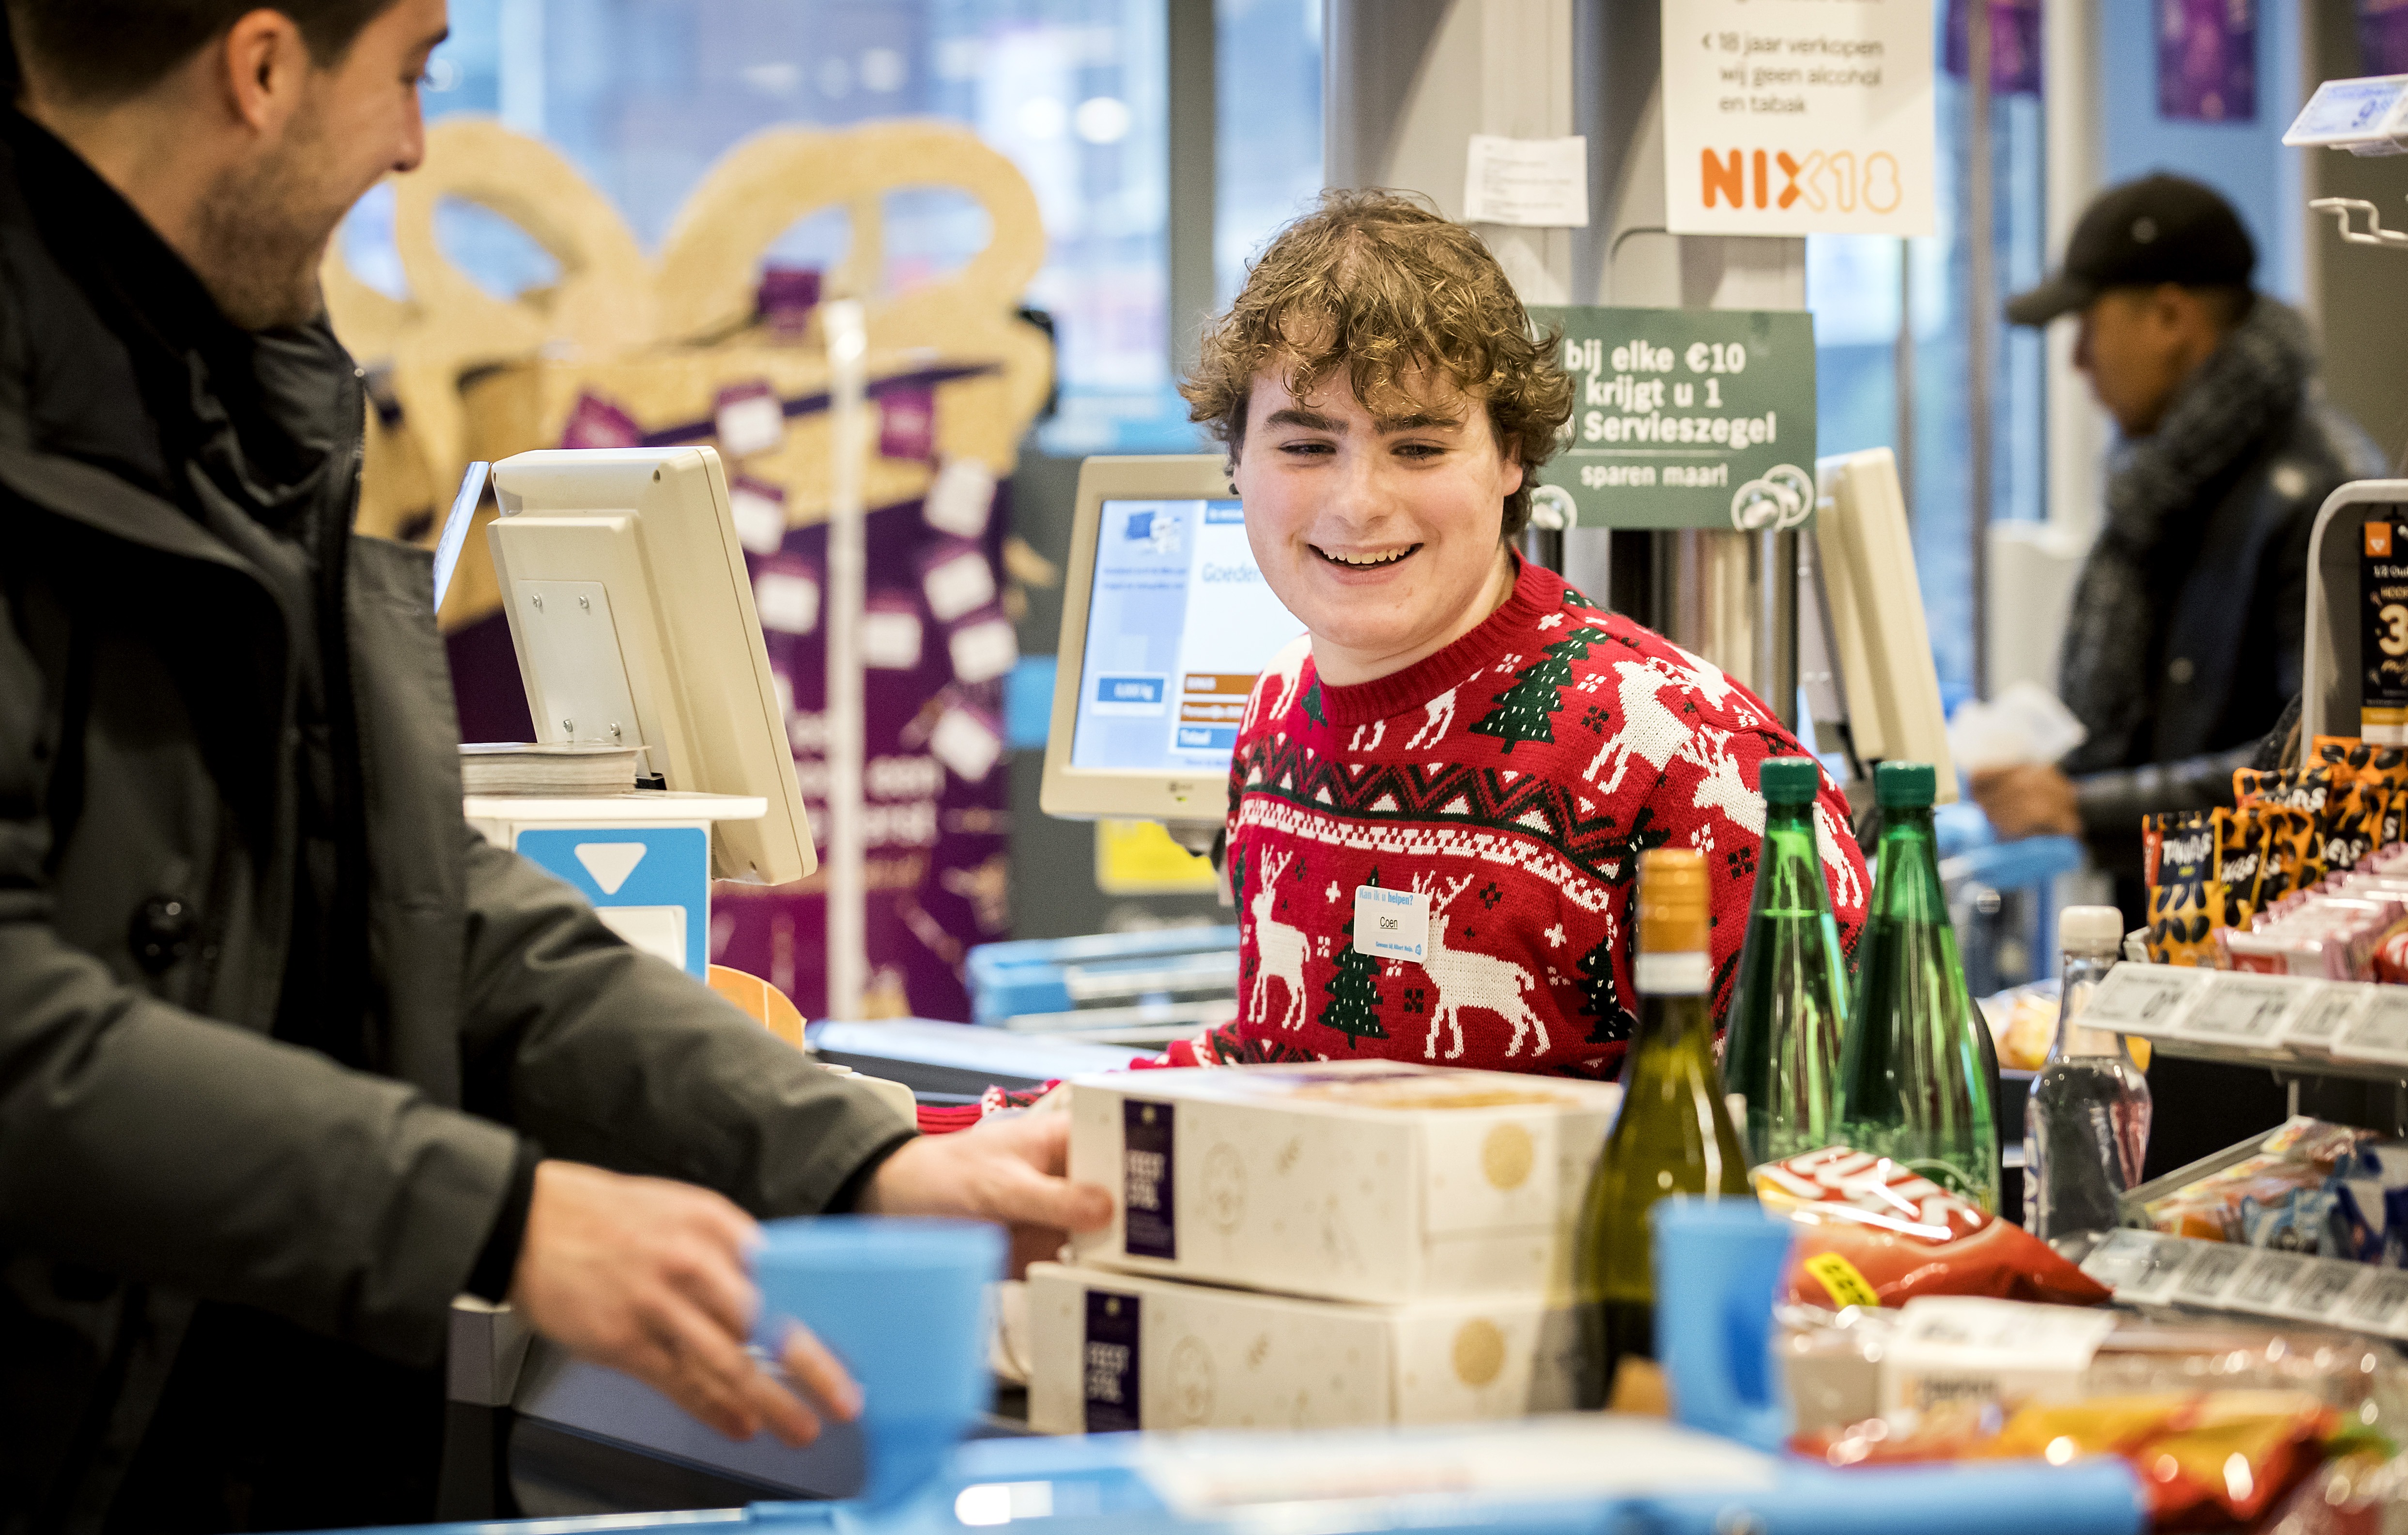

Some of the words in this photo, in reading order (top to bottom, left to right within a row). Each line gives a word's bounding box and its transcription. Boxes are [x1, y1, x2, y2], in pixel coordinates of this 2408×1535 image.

[1719, 32, 1740, 52] 18
[1744, 32, 1781, 57] jaar
[1789, 36, 1885, 58] verkopen
[1720, 64, 1746, 87] wij
[1752, 68, 1802, 89] geen
[1807, 66, 1883, 86] alcohol
[1719, 98, 1745, 113] en
[1750, 95, 1806, 113] tabak
[1565, 340, 1602, 376] bij
[1611, 340, 1675, 372] elke
[1685, 342, 1746, 373] €10
[1586, 374, 1665, 413] krijgt
[1674, 384, 1694, 407] u
[1705, 378, 1723, 408] 1
[1584, 411, 1776, 449] Servieszegel
[1580, 465, 1656, 489] sparen
[1663, 463, 1729, 487] maar!
[1359, 888, 1372, 899] Kan
[1374, 890, 1379, 901] ik
[1388, 892, 1413, 906] helpen?
[1380, 916, 1398, 928] Coen
